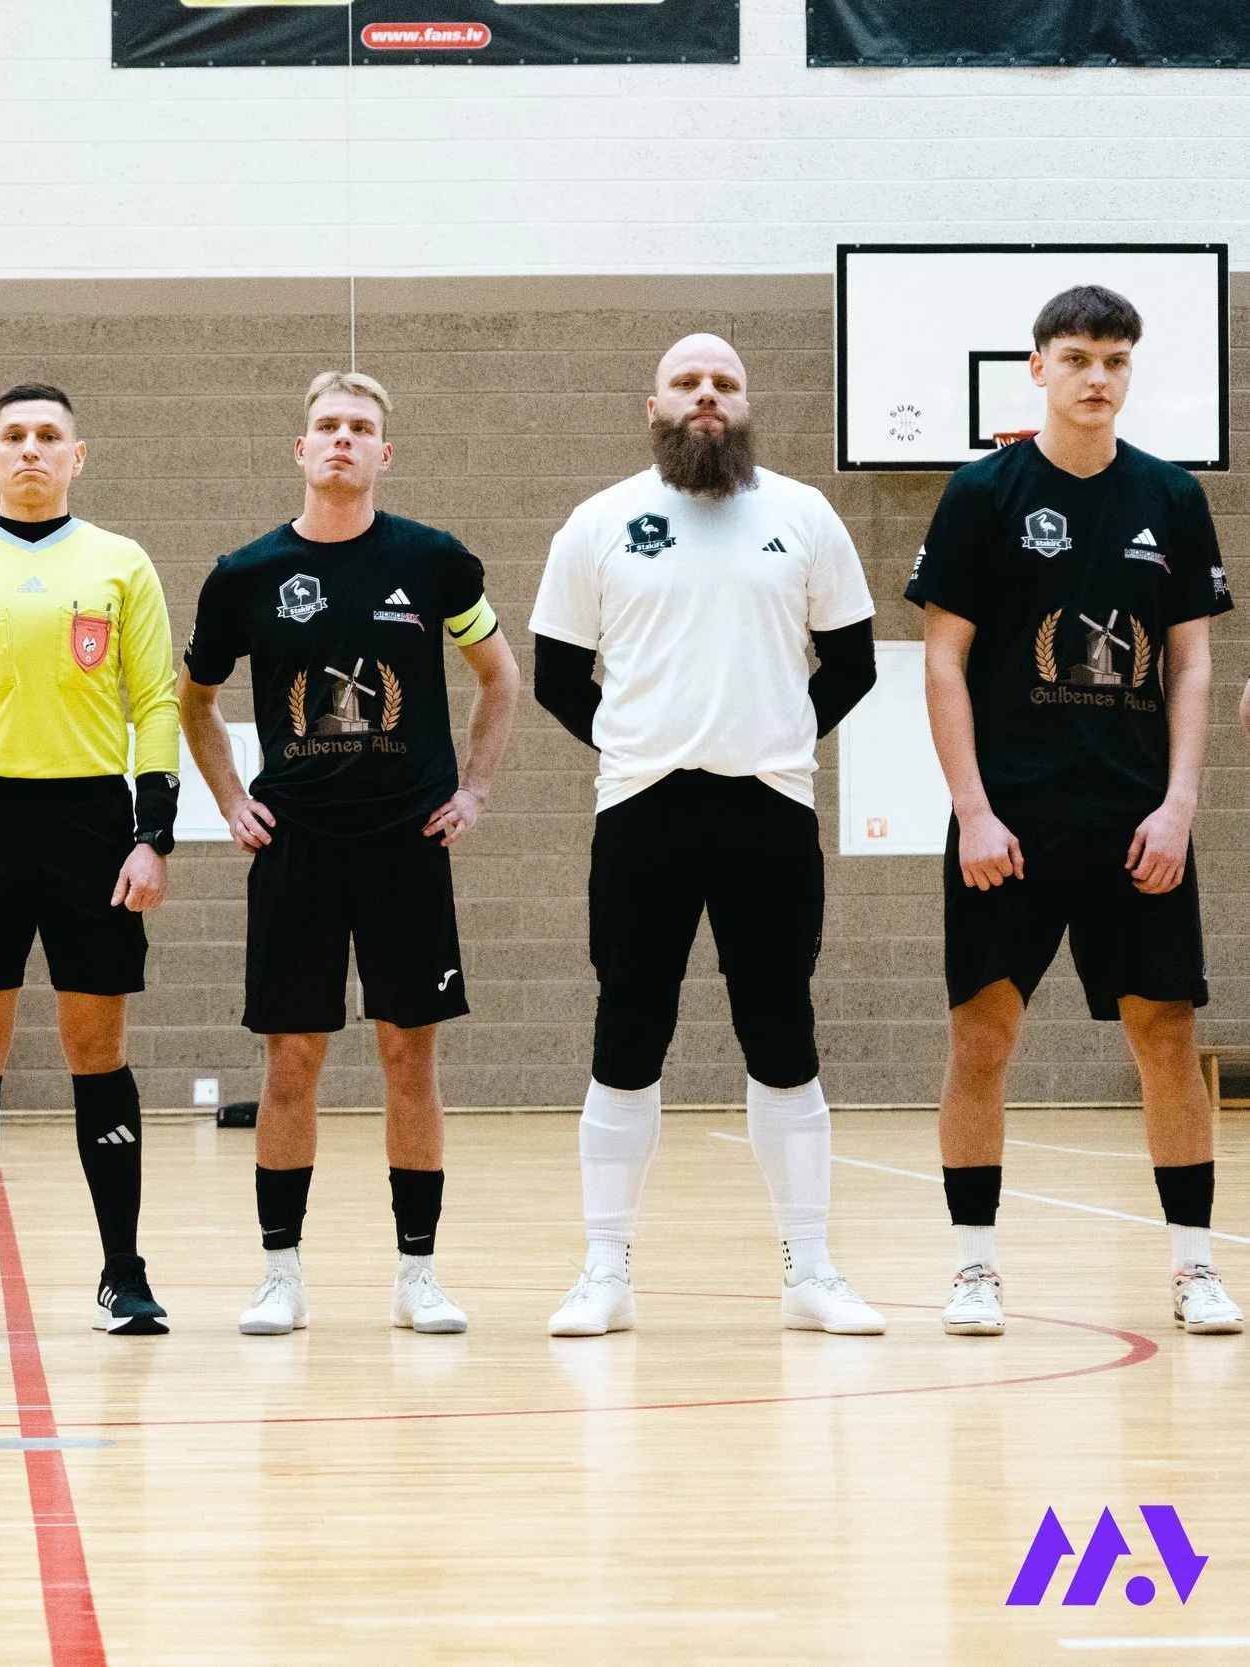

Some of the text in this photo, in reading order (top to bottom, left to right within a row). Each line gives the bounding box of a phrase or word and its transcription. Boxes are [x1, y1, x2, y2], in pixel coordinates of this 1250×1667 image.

[370, 27, 484, 43] www.fans.lv
[889, 404, 922, 418] SURE
[889, 428, 922, 442] SHOT
[1030, 685, 1115, 706] Gulbenes
[283, 735, 407, 759] Gulbenes Alus
